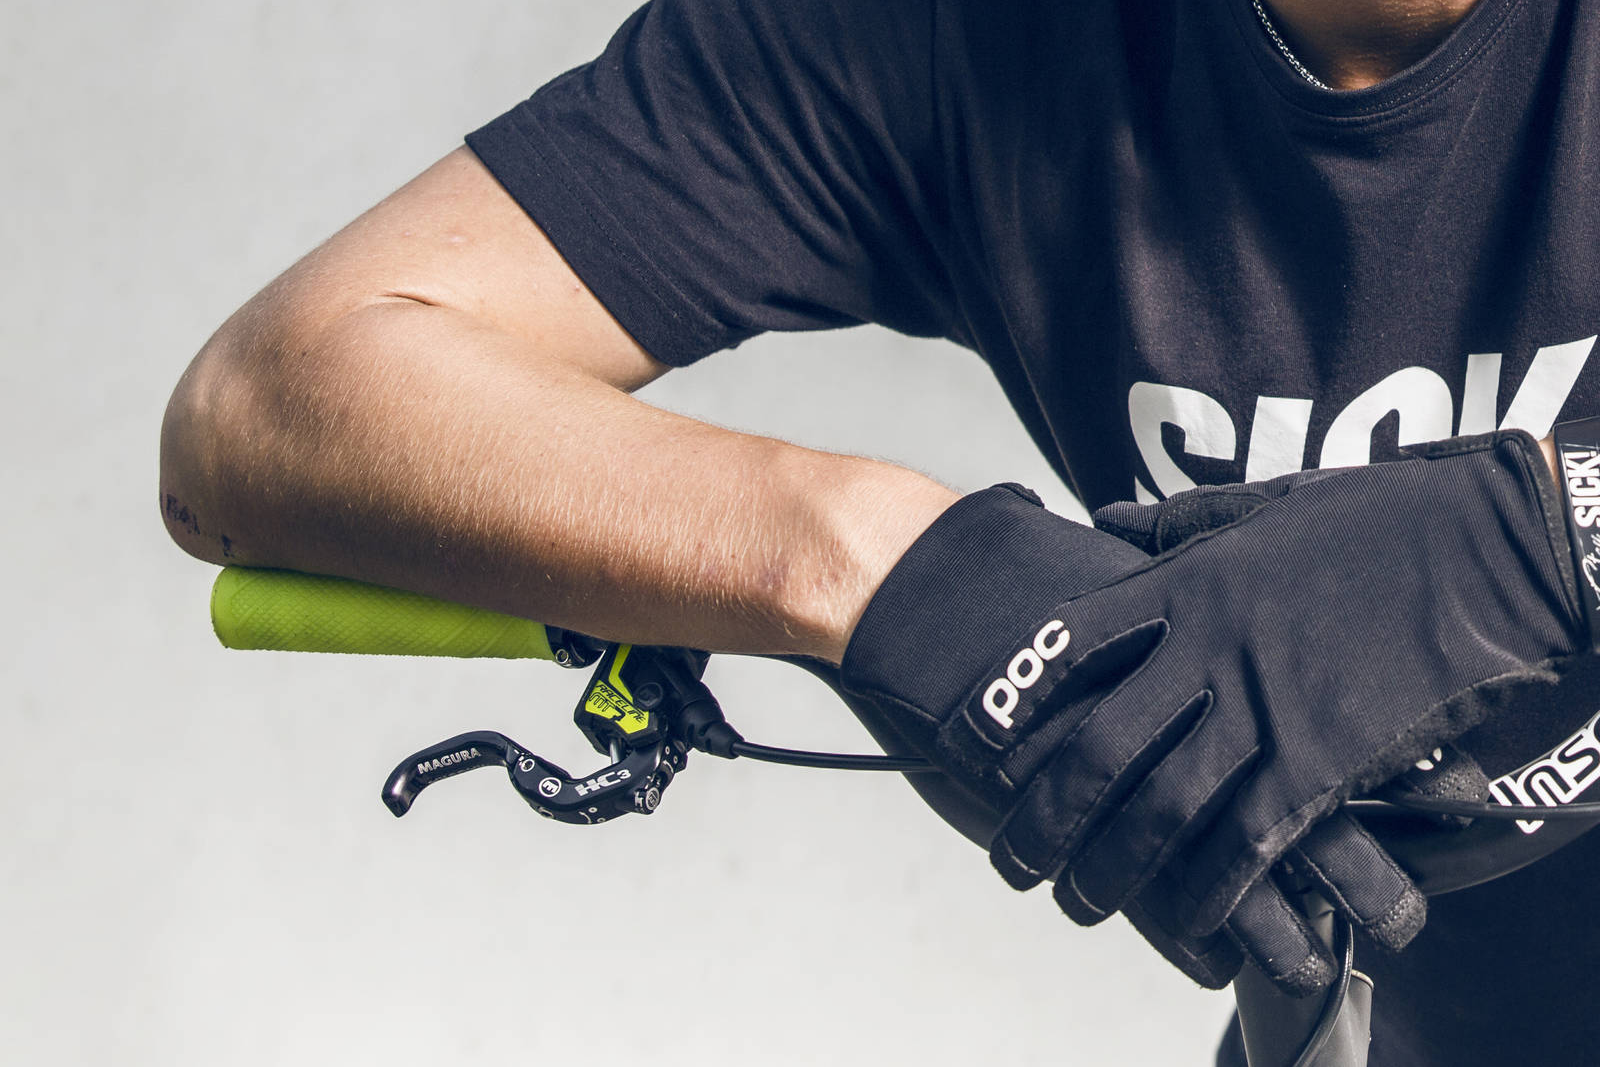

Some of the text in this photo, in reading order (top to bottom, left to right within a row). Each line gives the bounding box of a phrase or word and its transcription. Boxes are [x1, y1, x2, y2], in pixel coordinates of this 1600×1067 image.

[596, 684, 647, 724] RACELINE
[417, 747, 482, 774] MAGURA
[574, 768, 632, 797] HC3
